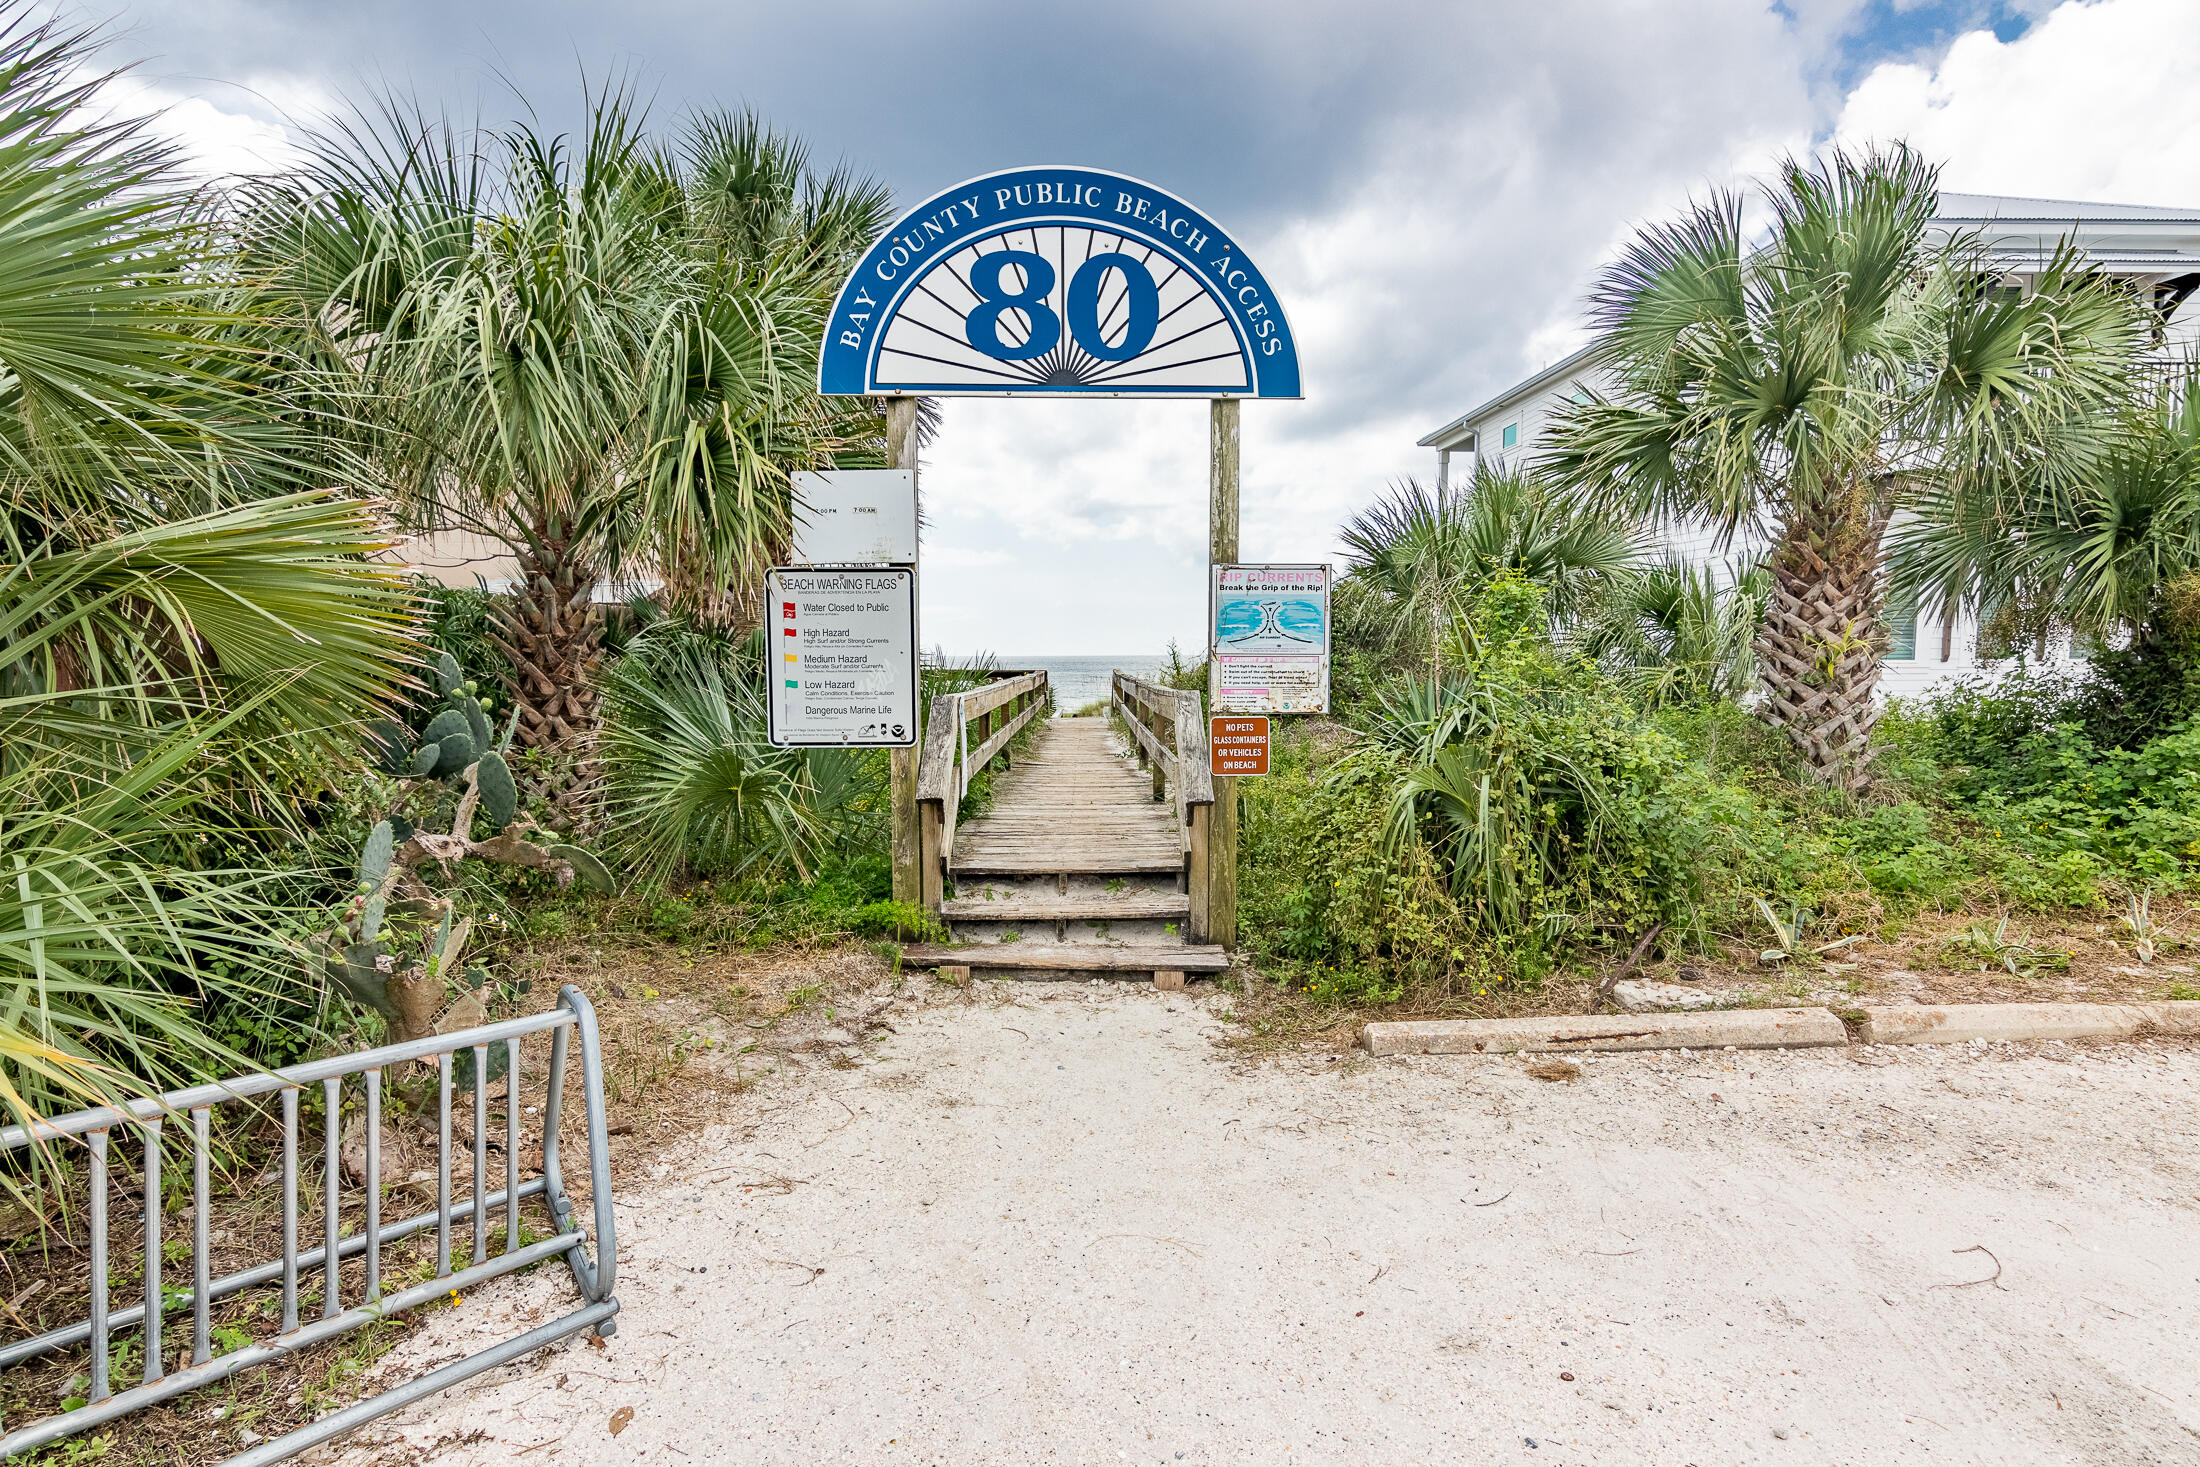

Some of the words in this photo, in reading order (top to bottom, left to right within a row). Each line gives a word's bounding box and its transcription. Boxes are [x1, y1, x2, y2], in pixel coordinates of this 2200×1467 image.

[839, 286, 877, 351] BAY
[876, 195, 981, 282] COUNTY
[993, 182, 1102, 211] PUBLIC
[1114, 191, 1211, 255] BEACH
[1210, 255, 1283, 357] ACCESS
[965, 249, 1160, 362] 80
[1220, 572, 1243, 583] RIP
[1247, 572, 1323, 583] CURRENTS
[782, 578, 815, 590] BEACH
[816, 578, 863, 590] WARNING
[865, 578, 897, 590] FLAGS
[1261, 584, 1279, 593] Grip
[1307, 584, 1323, 593] Rip!
[803, 603, 826, 612] Water
[827, 602, 855, 612] Closed
[857, 603, 865, 612] to
[866, 602, 889, 612] Public
[803, 629, 820, 639] High
[822, 629, 850, 637] Hazard
[804, 654, 836, 663] Medium
[838, 654, 868, 663] Hazard
[804, 680, 822, 689] Low
[824, 680, 855, 689] Hazard
[805, 705, 848, 716] Dangerous
[849, 705, 876, 714] Marine
[878, 705, 892, 714] Life
[1225, 723, 1236, 732] NO
[1236, 723, 1254, 731] PETS
[1213, 736, 1232, 744] GLASS
[1232, 735, 1267, 744] CONTAINERS
[1217, 748, 1228, 757] OR
[1229, 748, 1262, 757] VEHICLES
[1223, 761, 1233, 769] ON
[1234, 760, 1257, 769] BEACH
